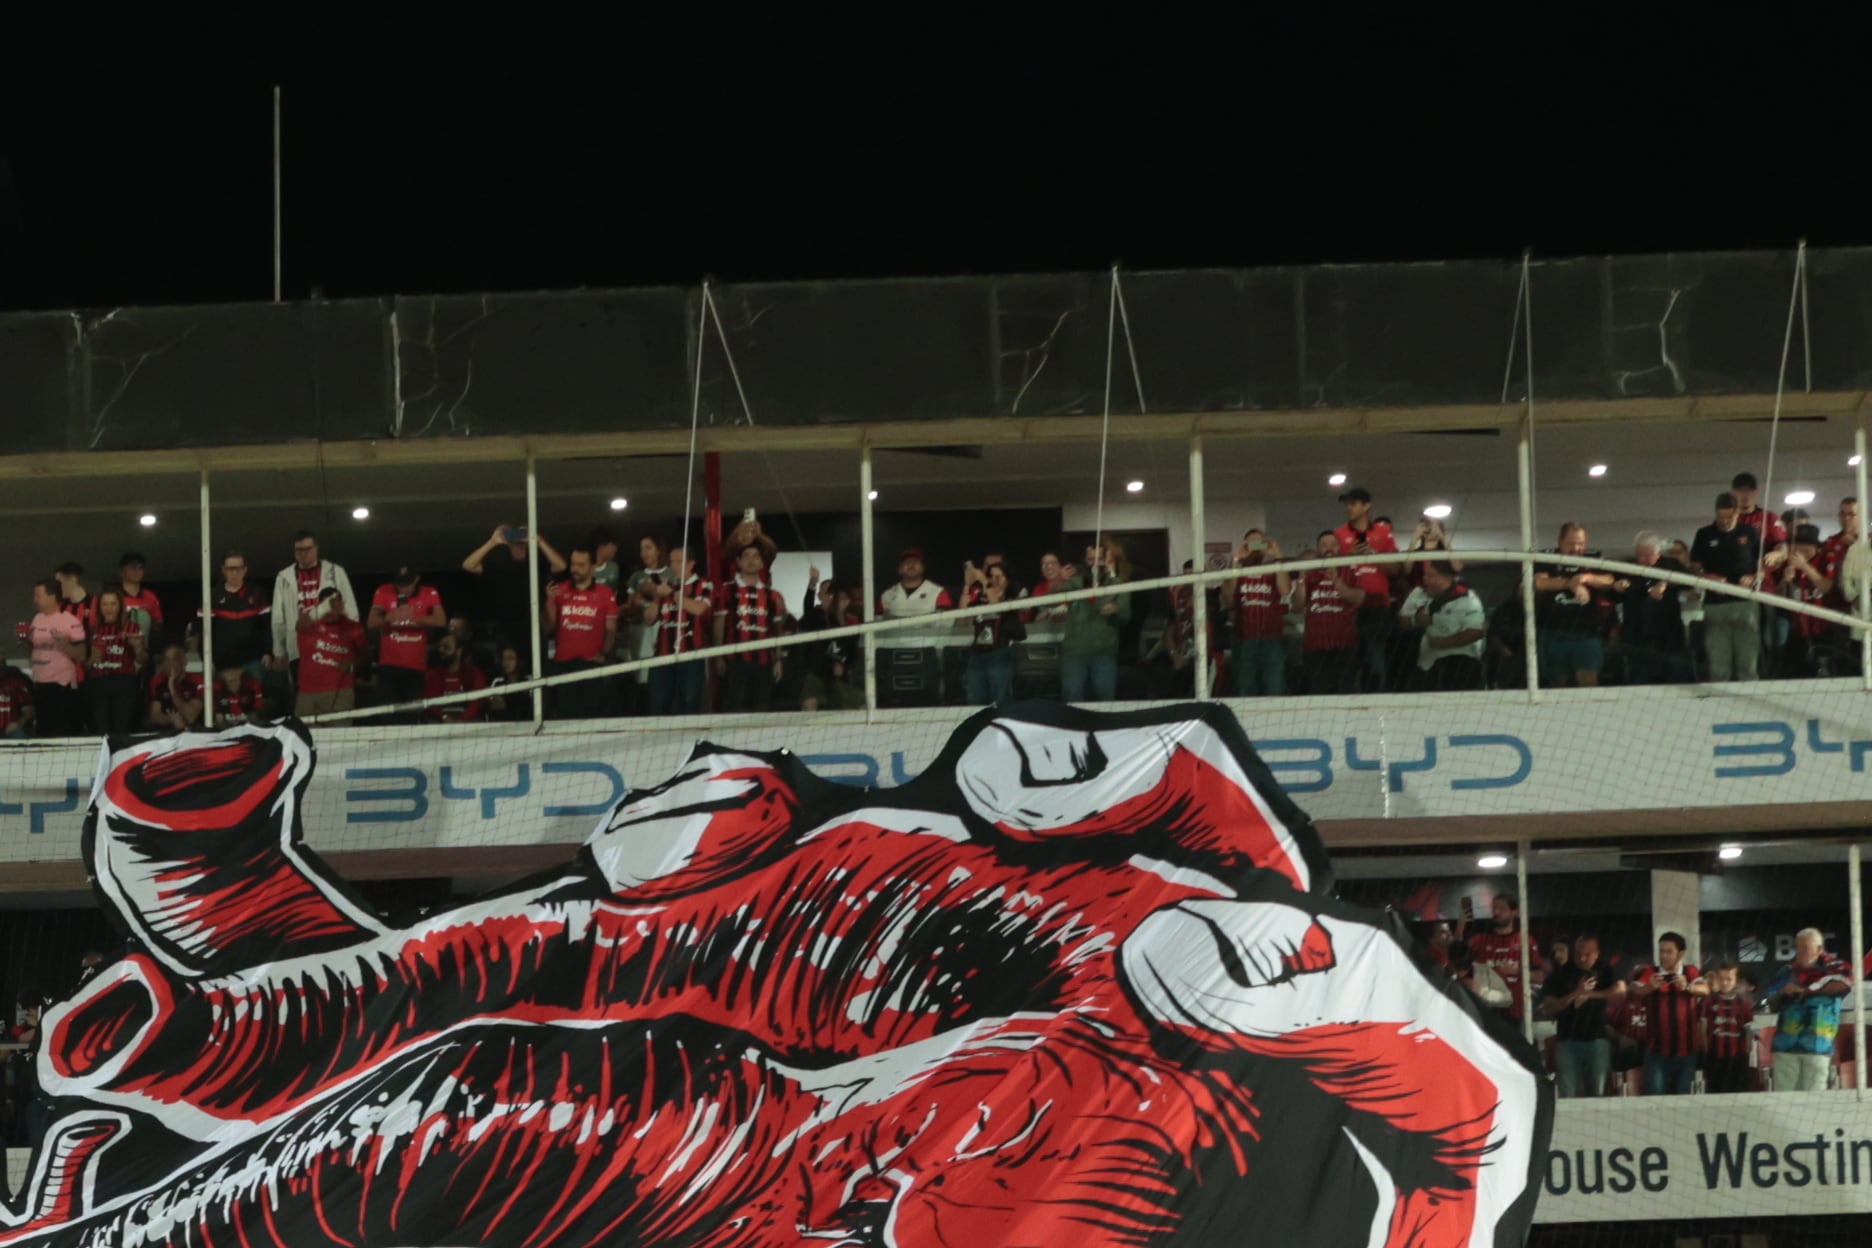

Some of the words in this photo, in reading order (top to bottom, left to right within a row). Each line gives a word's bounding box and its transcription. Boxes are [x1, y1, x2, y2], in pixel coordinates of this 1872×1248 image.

[1257, 733, 1533, 793] BYD
[1712, 718, 1872, 779] BY
[345, 760, 626, 823] BYD
[1696, 1128, 1872, 1189] Westin
